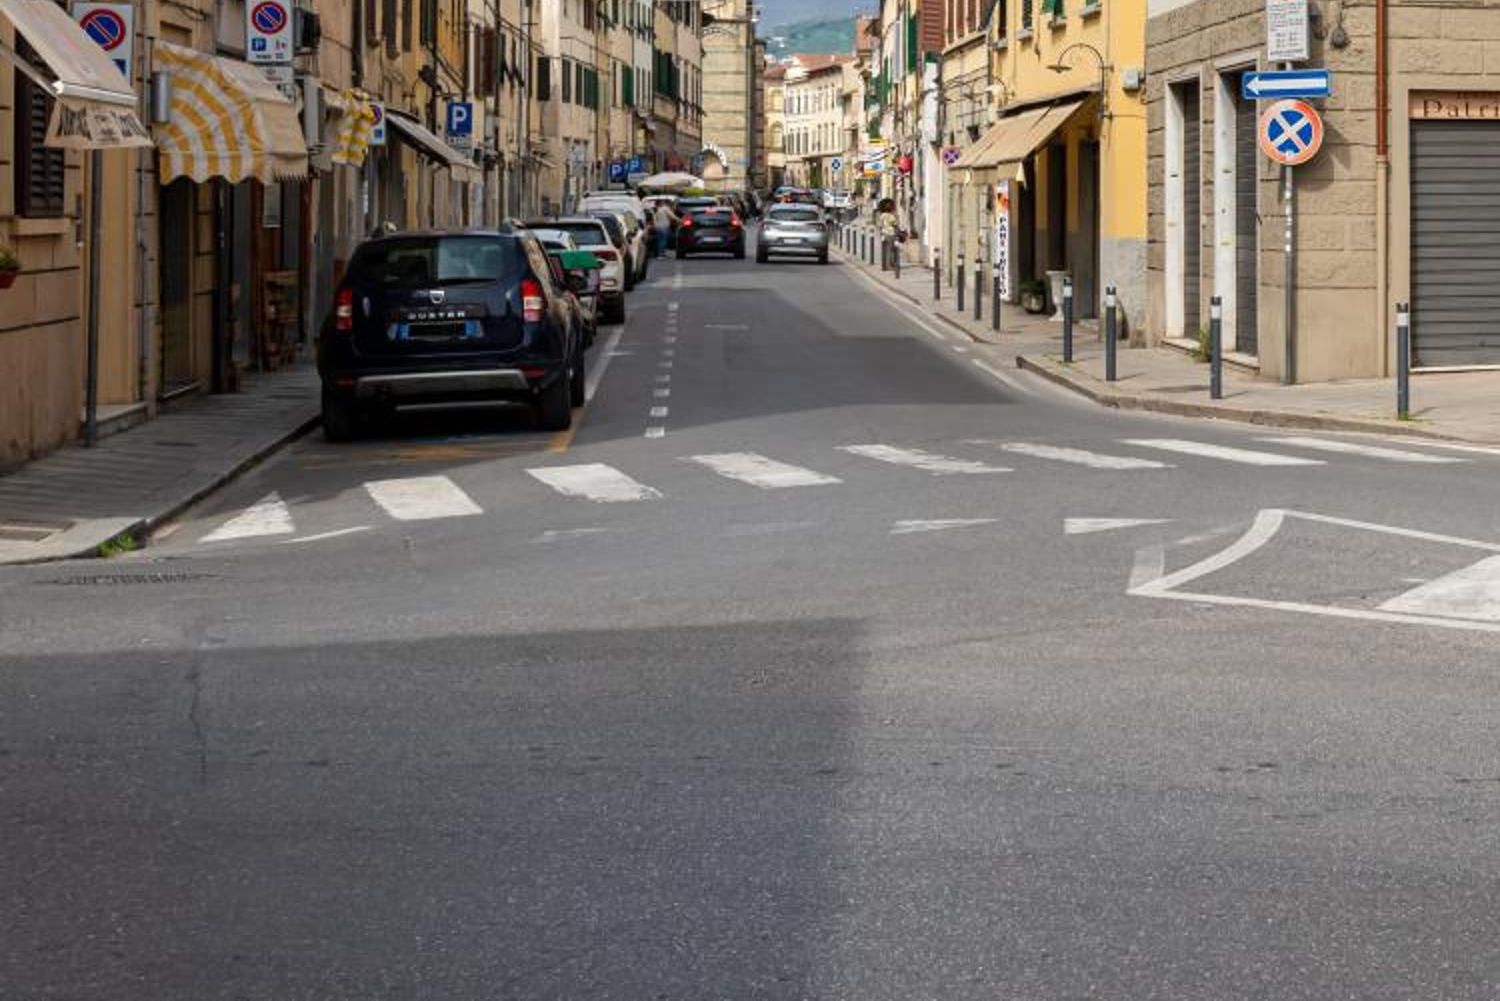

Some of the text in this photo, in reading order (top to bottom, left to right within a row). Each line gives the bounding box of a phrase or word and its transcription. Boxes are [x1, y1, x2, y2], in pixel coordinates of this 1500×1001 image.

[452, 105, 467, 131] P
[611, 166, 622, 178] P
[407, 311, 466, 320] DUSTER
